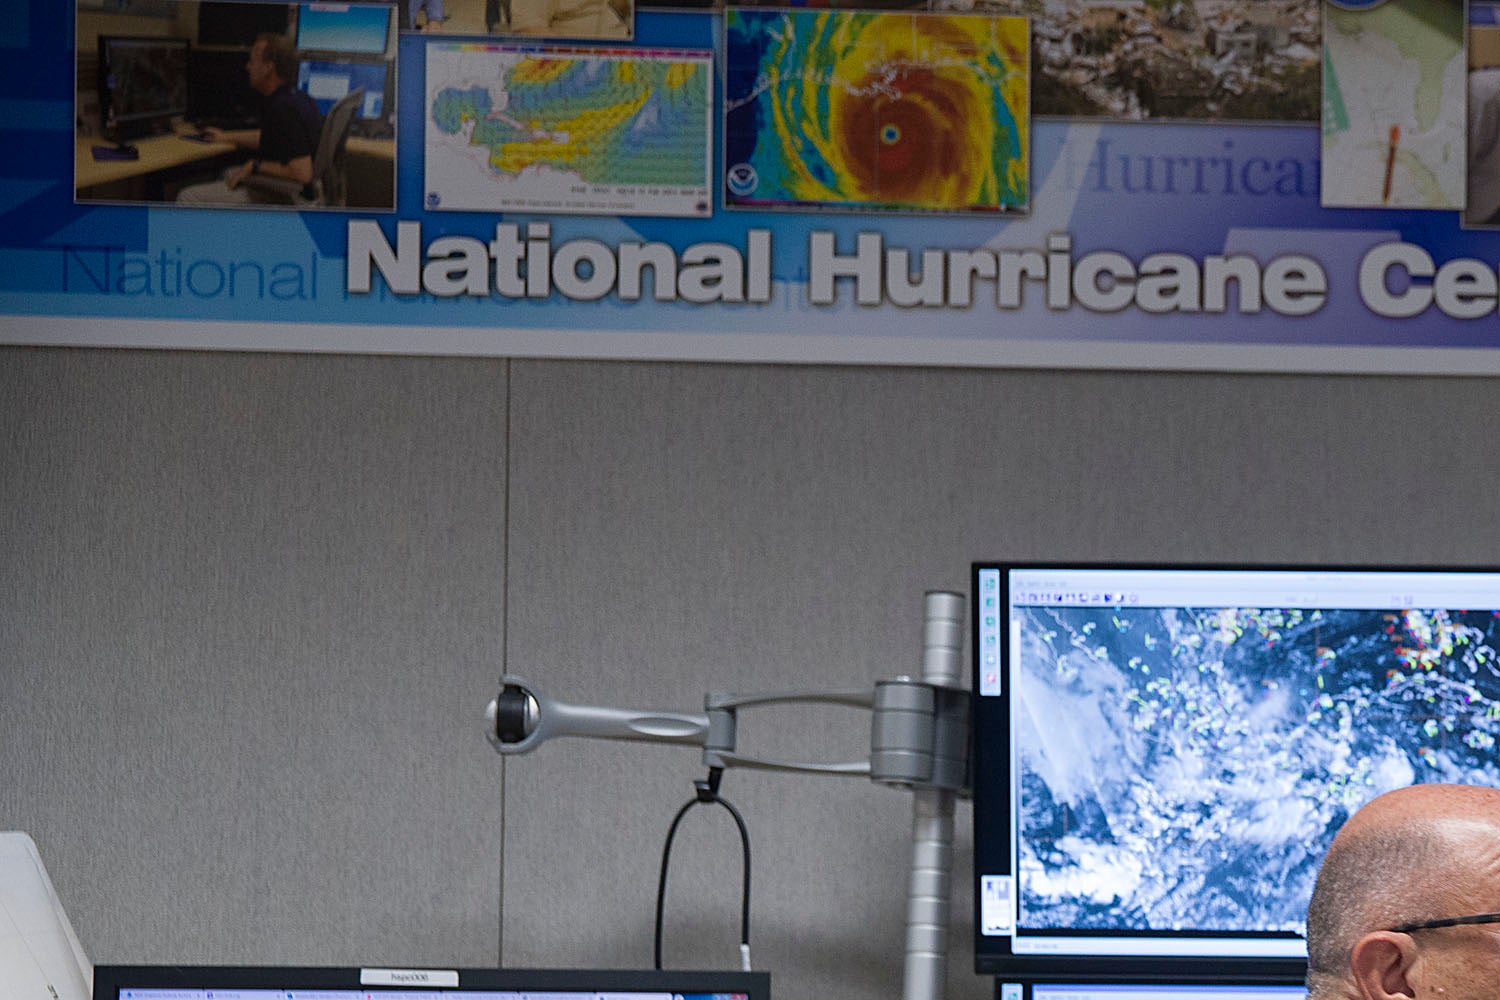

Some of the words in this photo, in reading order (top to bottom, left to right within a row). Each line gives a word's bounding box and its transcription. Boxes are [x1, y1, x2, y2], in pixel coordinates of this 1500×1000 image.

[1056, 138, 1321, 197] Hurrica
[61, 245, 318, 300] National
[346, 219, 773, 302] National
[808, 230, 1327, 316] Hurricane
